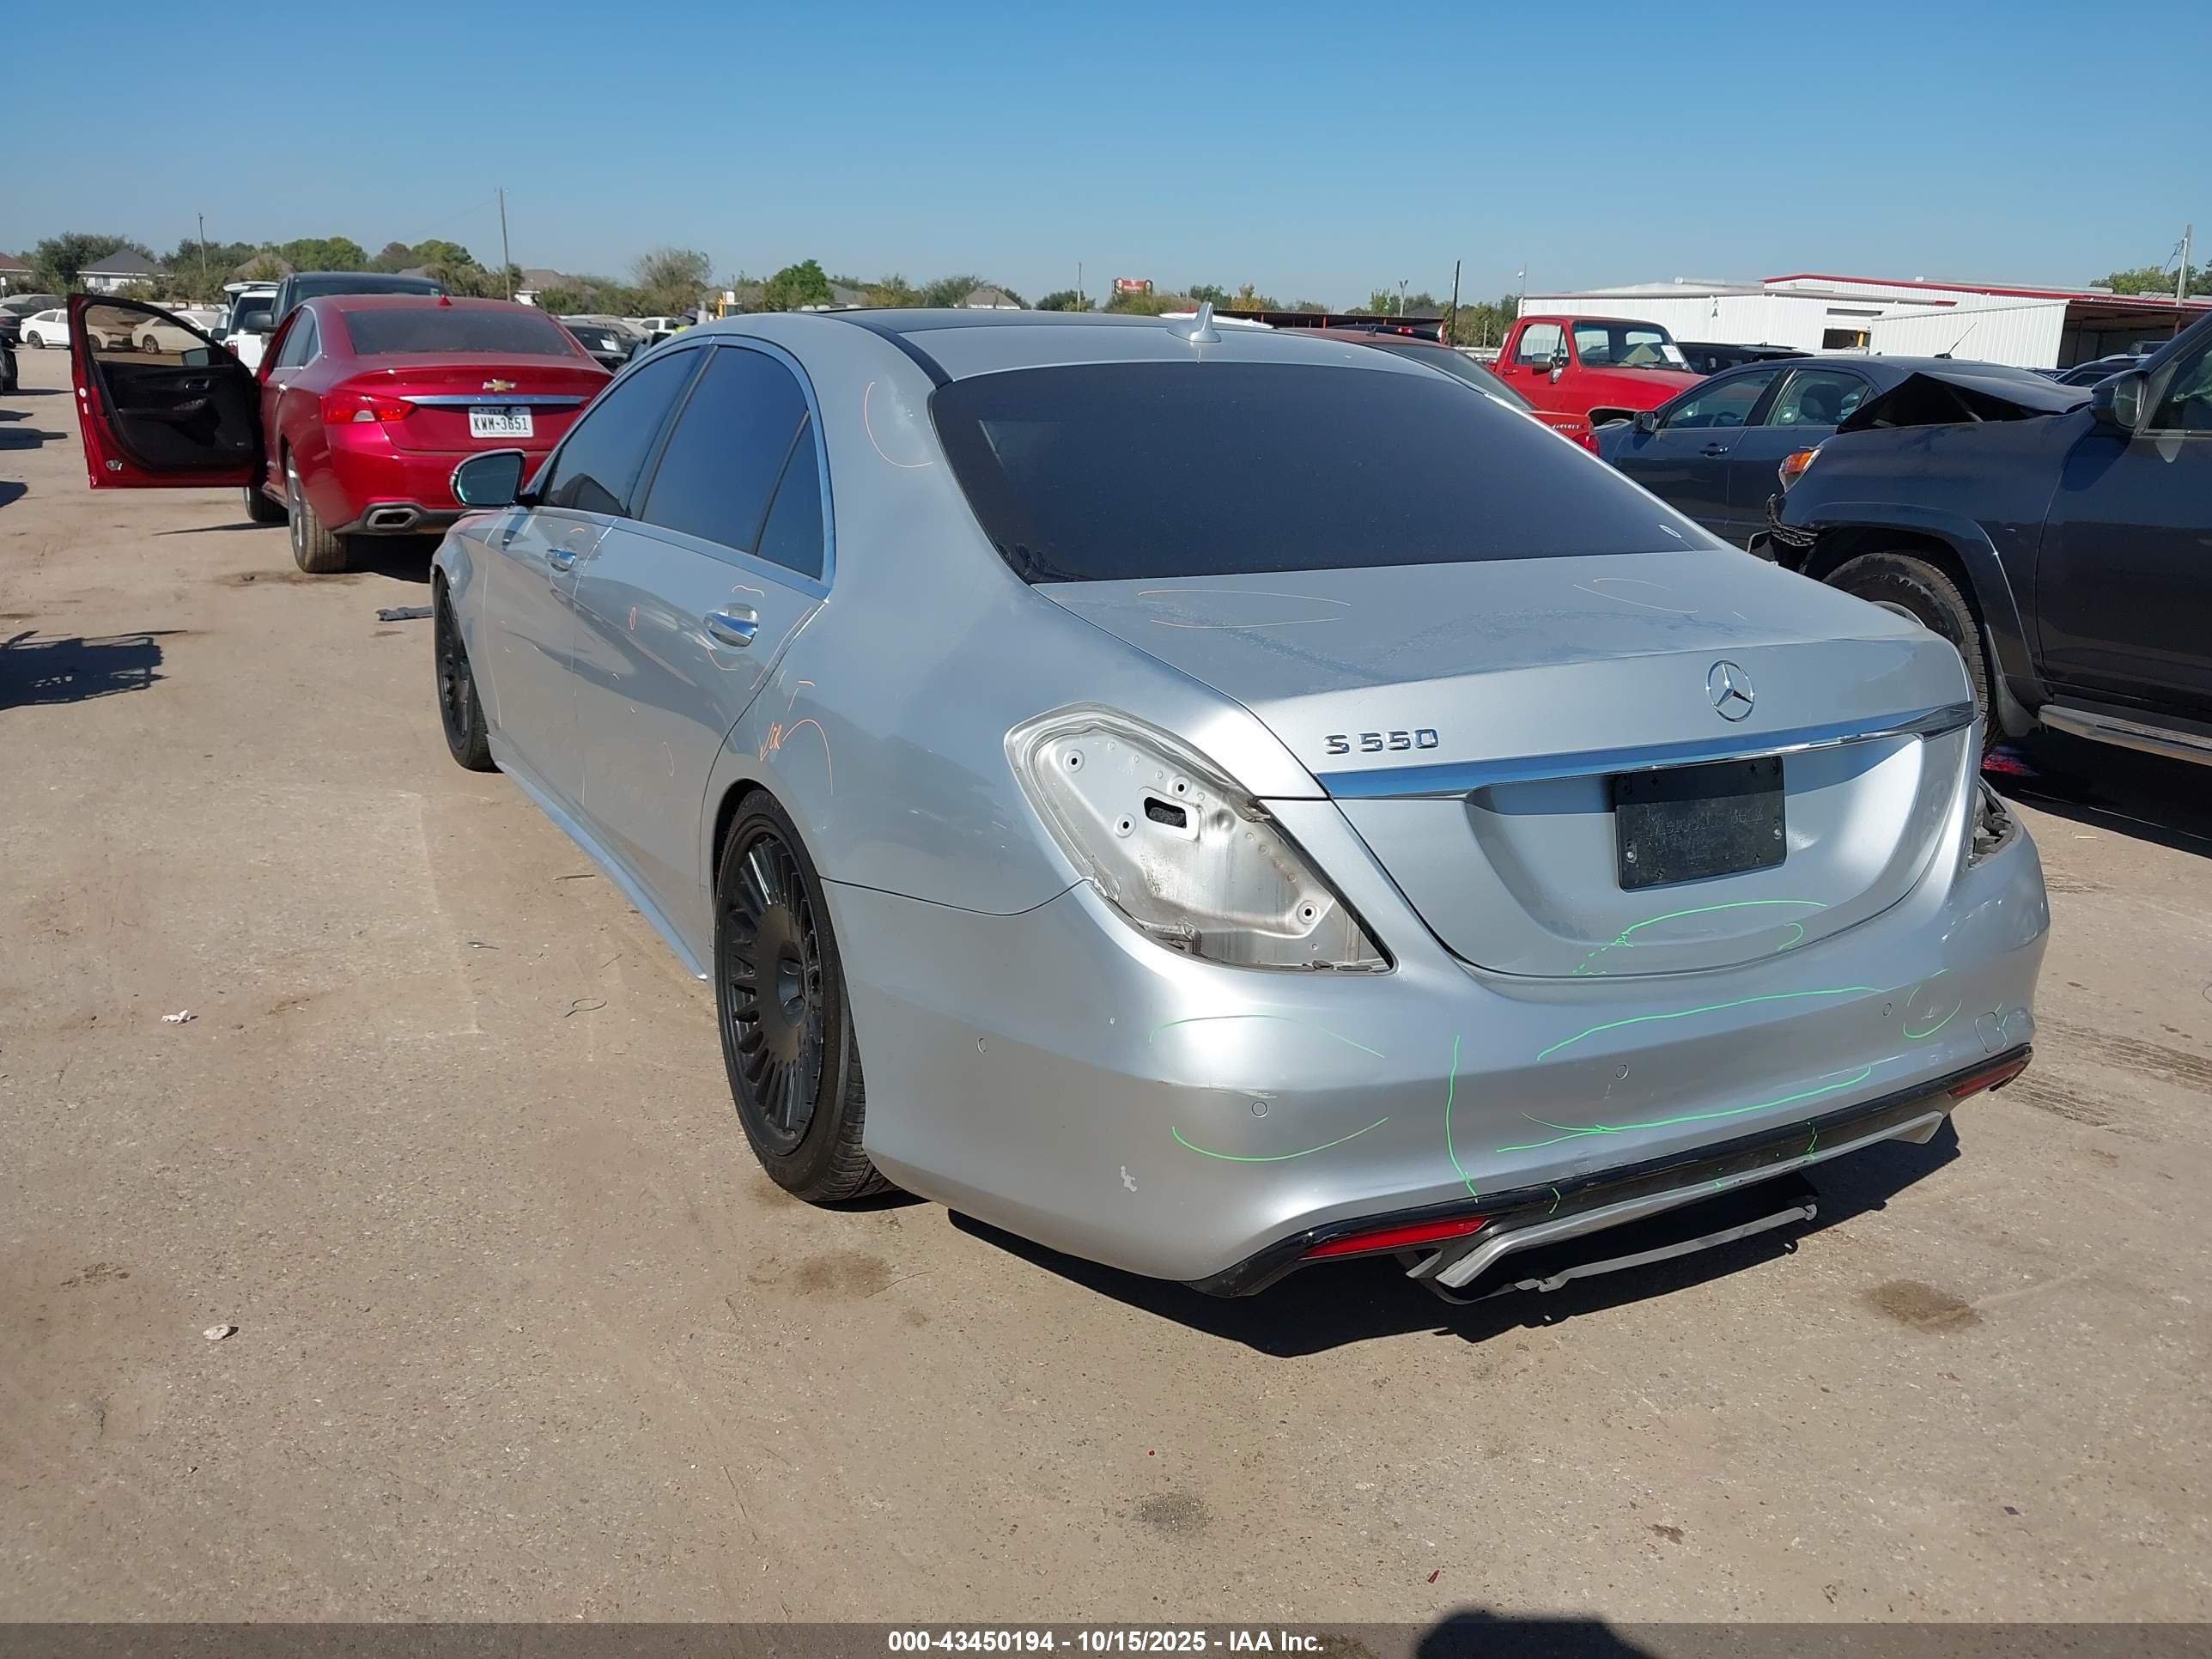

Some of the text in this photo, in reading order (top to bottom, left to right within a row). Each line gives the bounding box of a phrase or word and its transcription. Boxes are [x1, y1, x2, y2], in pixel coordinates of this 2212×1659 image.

[473, 417, 529, 430] KWM-3651
[1324, 728, 1439, 755] S 550
